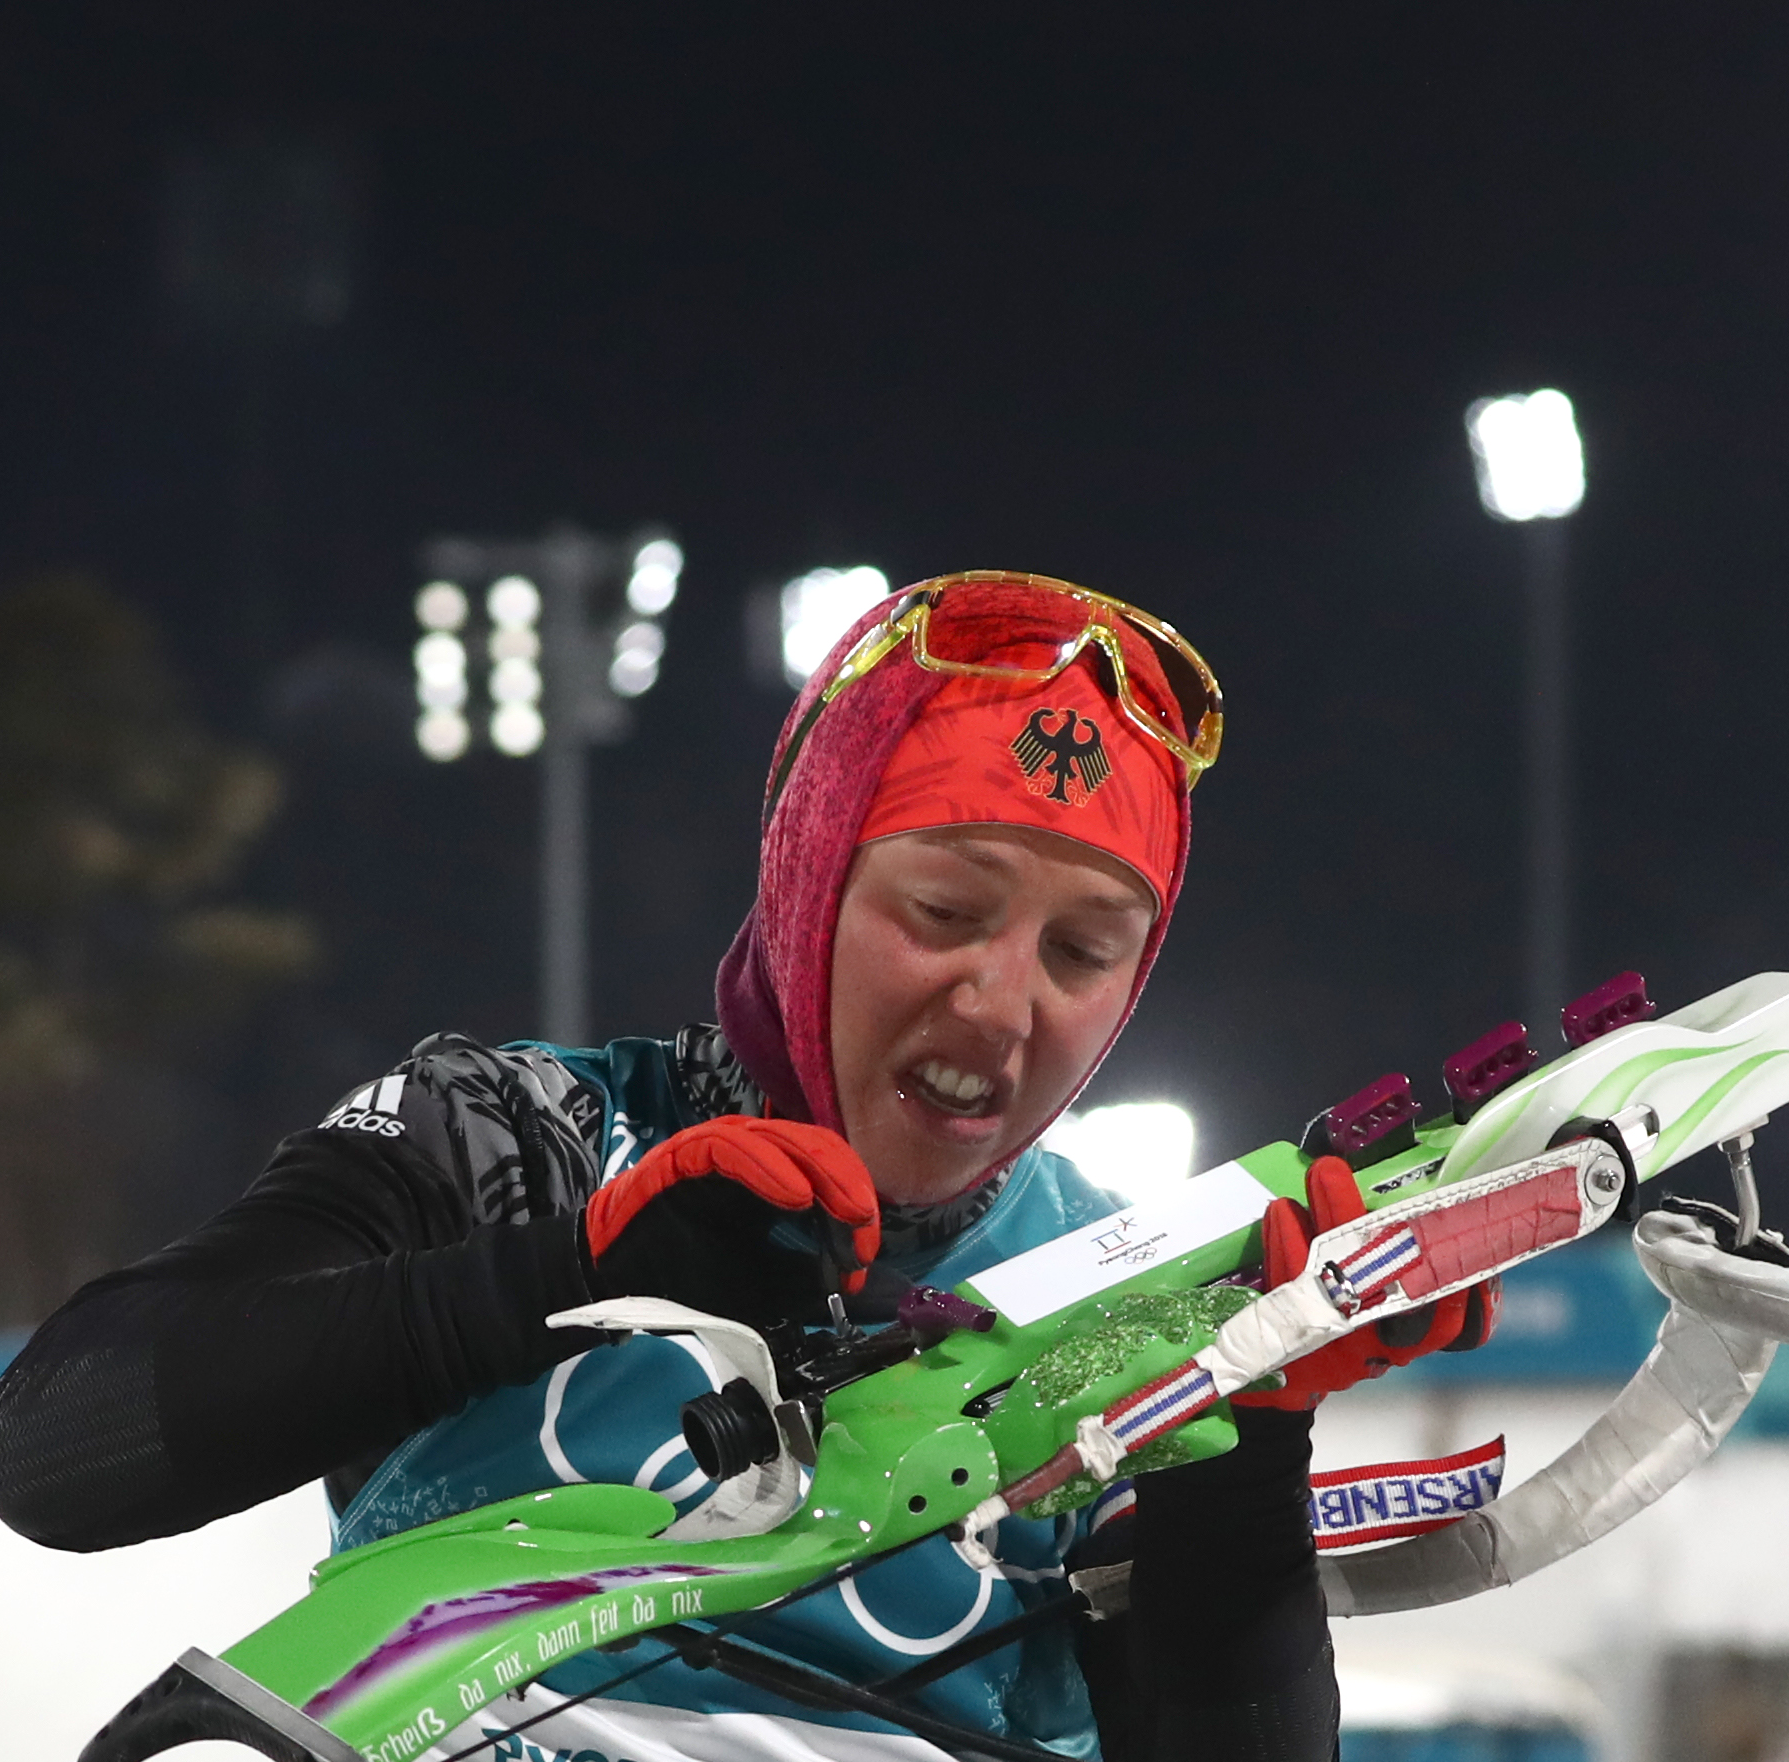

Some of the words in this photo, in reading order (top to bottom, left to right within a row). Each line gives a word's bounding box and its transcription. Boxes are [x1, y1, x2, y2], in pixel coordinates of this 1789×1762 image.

[459, 1680, 484, 1711] da
[536, 1621, 581, 1660] dann
[632, 1594, 655, 1623] da
[672, 1585, 703, 1616] nix
